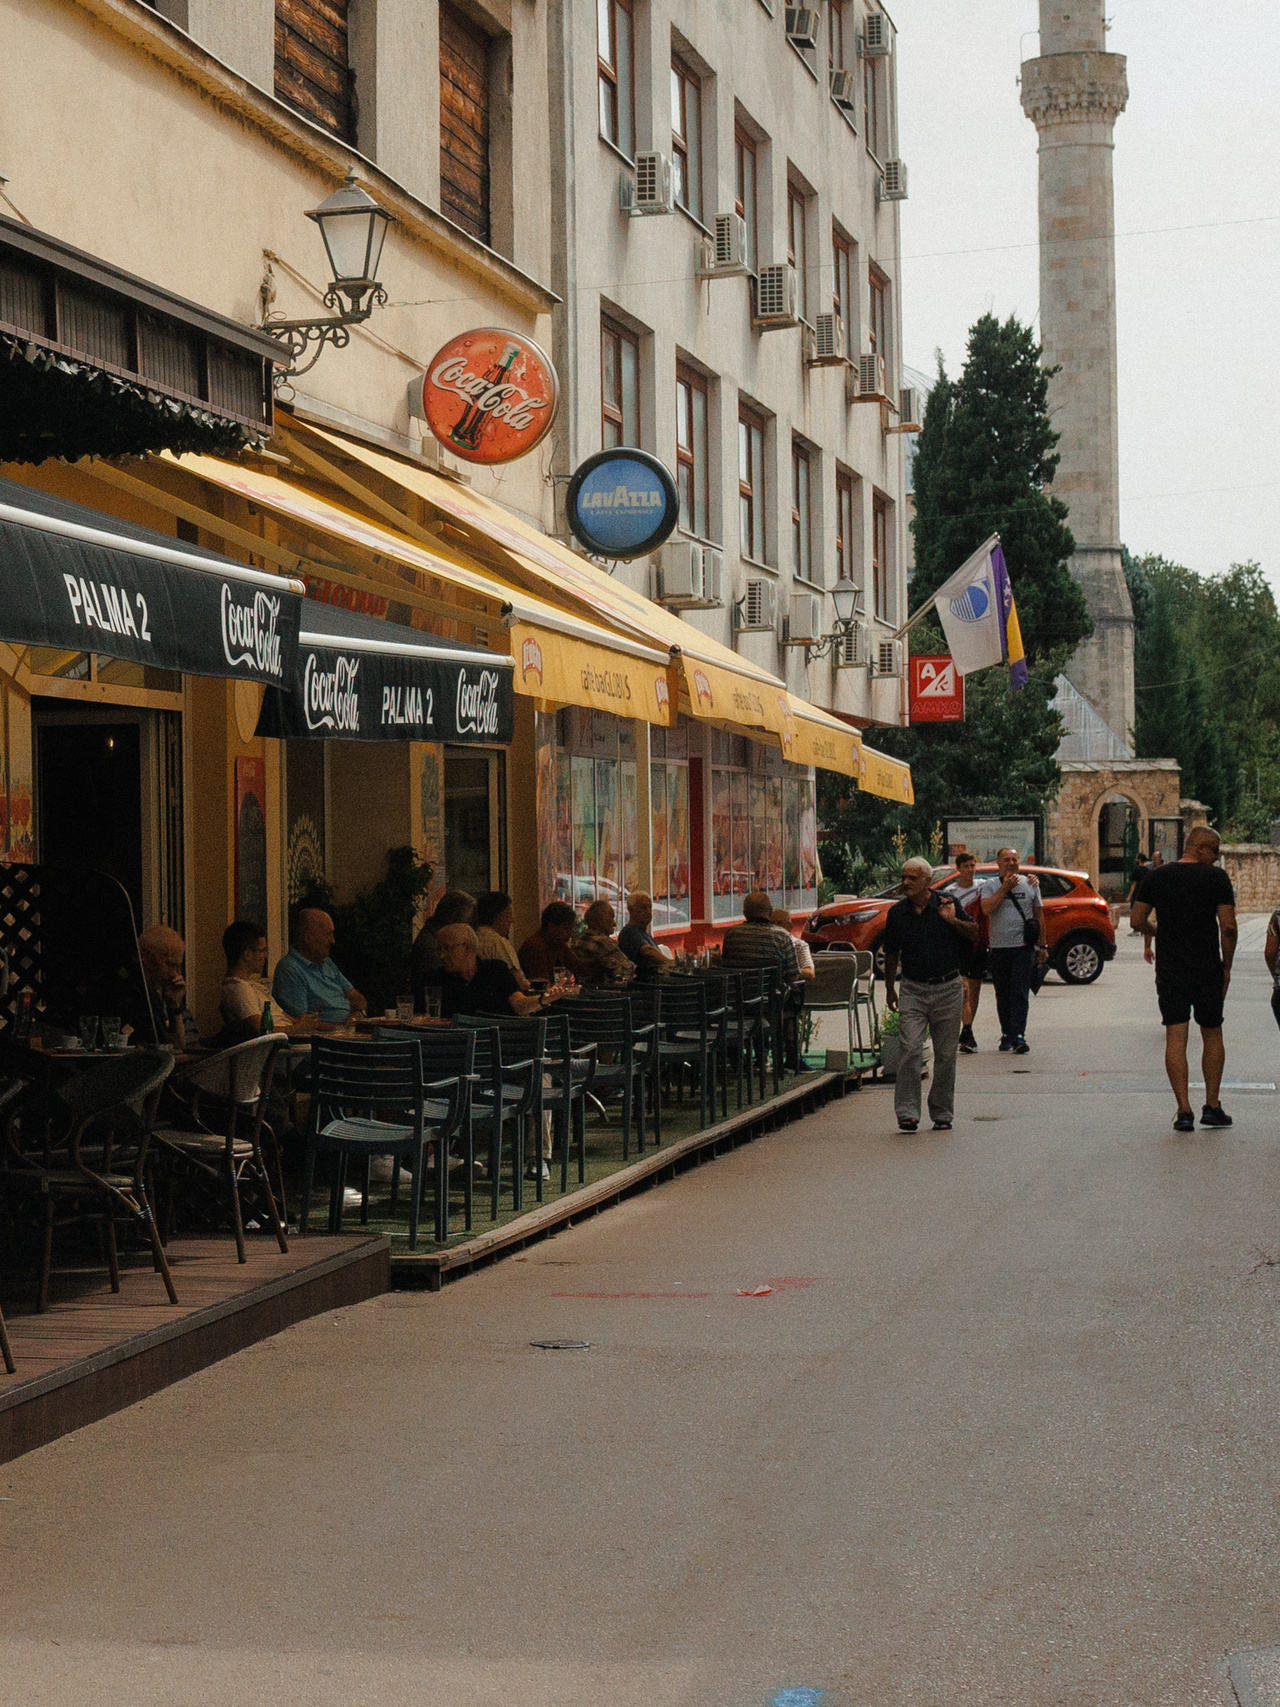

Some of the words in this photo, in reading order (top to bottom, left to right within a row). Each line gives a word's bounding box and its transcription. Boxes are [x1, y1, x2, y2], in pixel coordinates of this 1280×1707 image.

[432, 356, 548, 431] Coca-Cola
[582, 486, 662, 508] LAVAZZA
[63, 573, 138, 639] PALMA
[137, 592, 152, 642] 2
[221, 582, 283, 678] Coca-Cola
[304, 653, 360, 731] Coca-Cola
[382, 686, 422, 724] PALMA
[426, 688, 433, 724] 2
[456, 667, 499, 735] Coca-Cola
